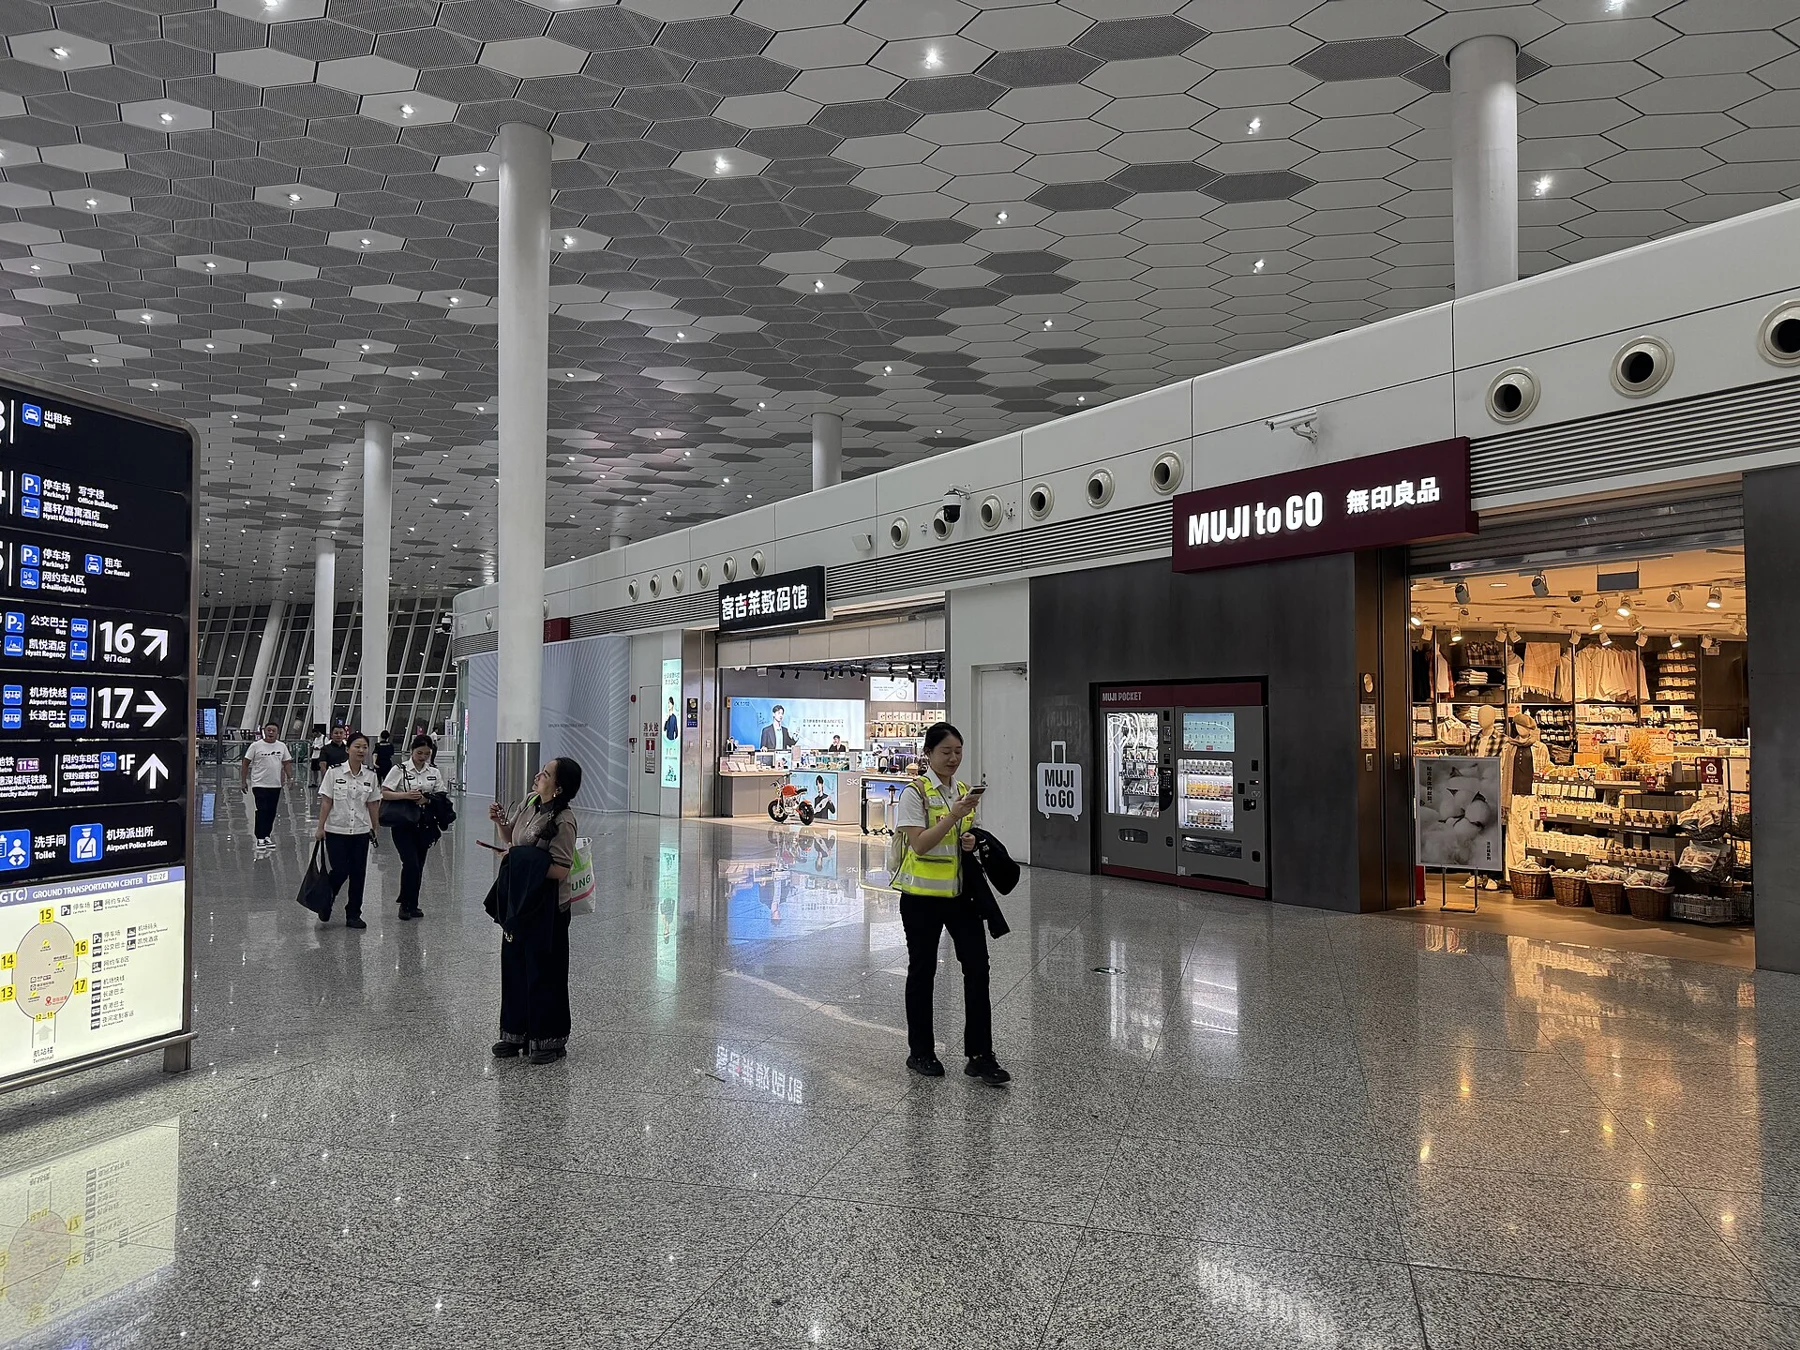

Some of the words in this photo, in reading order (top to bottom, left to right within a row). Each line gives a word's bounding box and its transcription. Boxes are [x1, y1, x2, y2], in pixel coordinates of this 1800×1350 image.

[44, 410, 72, 426] 出租车
[43, 479, 71, 493] 停车场
[78, 486, 105, 500] 写字楼
[43, 490, 65, 501] Parking
[1346, 476, 1441, 515] 無印良品
[78, 497, 93, 505] Office
[1188, 501, 1250, 547] MUJI
[1254, 501, 1282, 536] to
[1285, 491, 1324, 532] GO
[42, 548, 71, 562] 停车场
[42, 560, 64, 569] Parking
[105, 557, 122, 568] 租车
[42, 571, 86, 586] 网约车A区
[114, 569, 130, 577] Rental
[721, 584, 808, 620] 客吉莱数码馆
[30, 615, 68, 628] 公交巴士
[99, 621, 136, 654] 16
[29, 638, 67, 651] 凯悦酒店
[25, 650, 41, 659] Hyatt
[42, 650, 66, 659] Regency
[103, 654, 117, 662] 号门
[117, 656, 131, 664] Gate
[29, 687, 68, 699] 机场快线
[1102, 692, 1117, 702] MUJI
[1118, 692, 1142, 701] POCKET
[98, 687, 134, 719] 17
[28, 710, 67, 721] 长途巴士
[49, 721, 66, 729] Coach
[101, 721, 115, 729] 号门
[63, 754, 100, 763] 网约车B区
[118, 754, 136, 771] 1F
[1044, 769, 1074, 788] MUJI
[0, 784, 52, 792] uangzhou-Shenzhen
[1045, 789, 1057, 808] to
[1058, 790, 1074, 809] GO
[106, 826, 154, 840] 机场派出所
[34, 834, 67, 848] 洗手间
[106, 843, 128, 852] Airport
[128, 841, 146, 850] Police
[147, 839, 168, 848] Station
[34, 851, 56, 860] Toilet
[33, 890, 63, 899] GROUND
[63, 880, 119, 895] TRANSPORTATION
[120, 877, 144, 887] CENTER
[40, 909, 51, 920] 15
[75, 941, 86, 952] 16
[1, 954, 14, 965] 14
[75, 980, 86, 991] 17
[1, 986, 13, 998] 13
